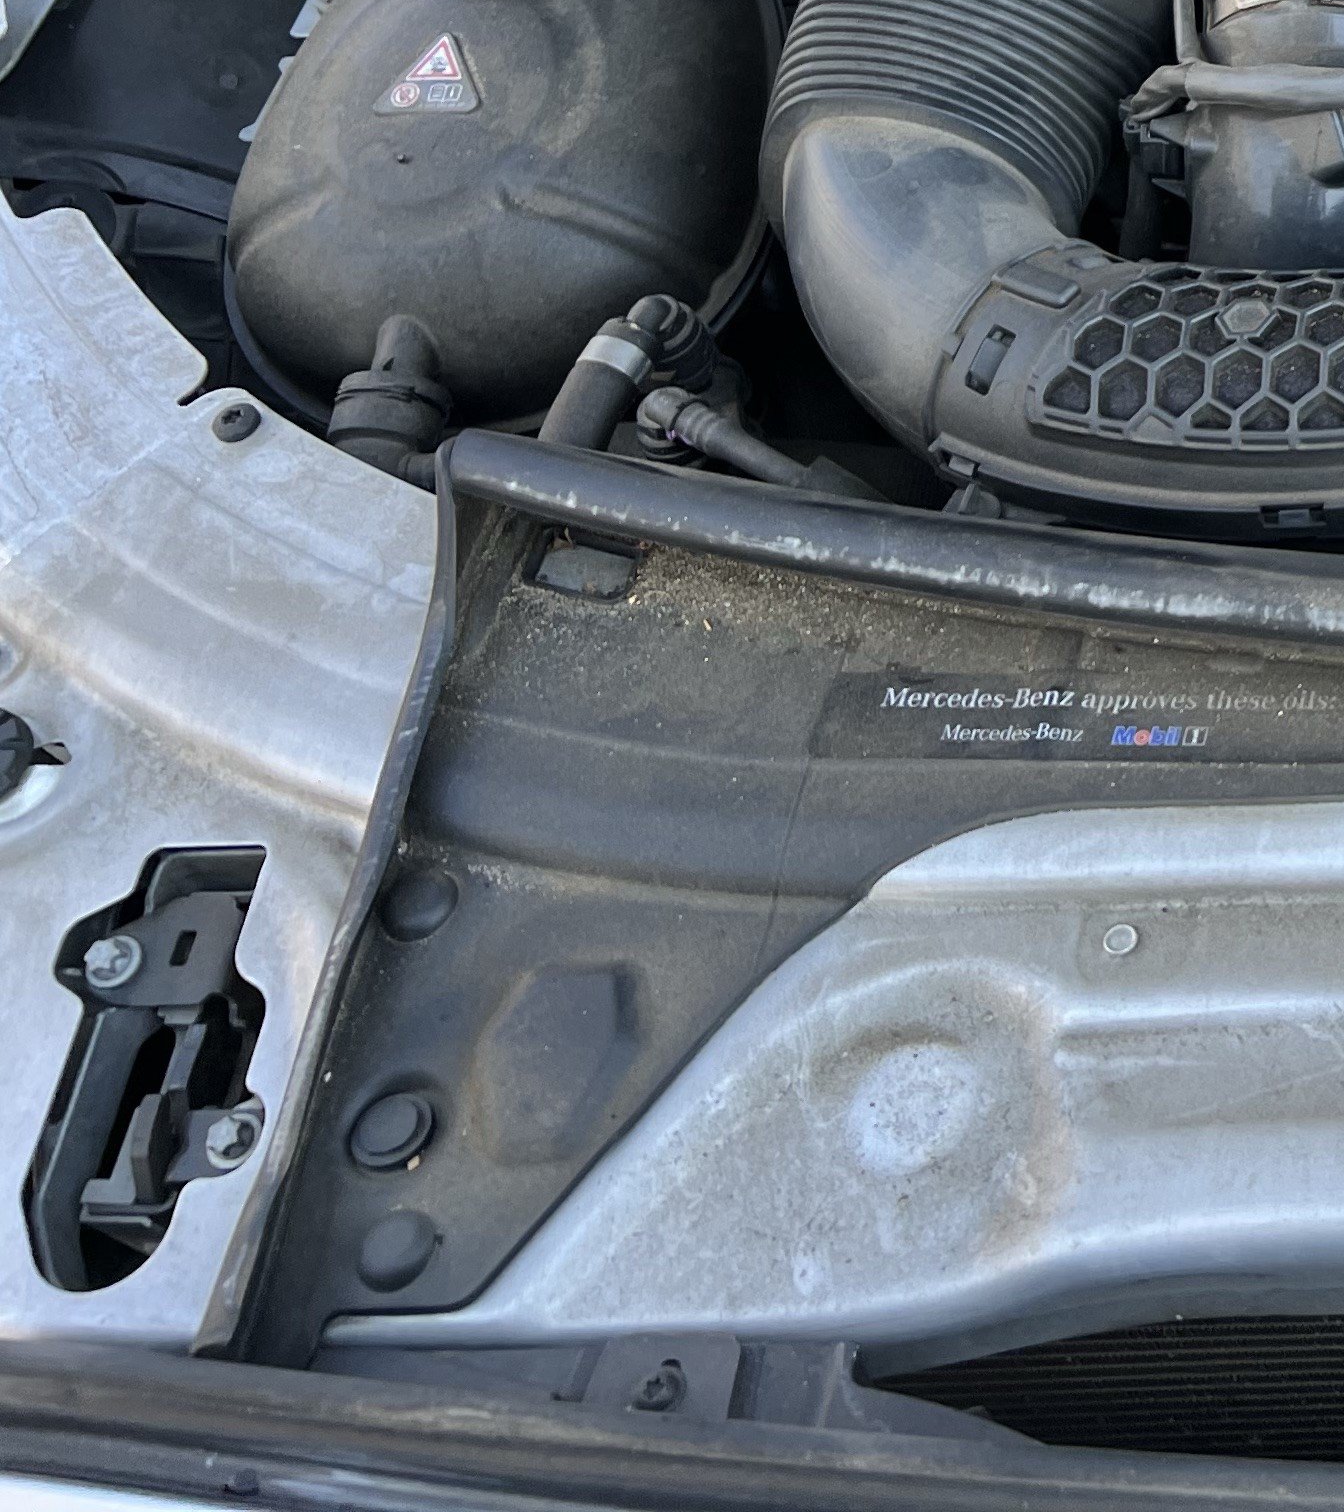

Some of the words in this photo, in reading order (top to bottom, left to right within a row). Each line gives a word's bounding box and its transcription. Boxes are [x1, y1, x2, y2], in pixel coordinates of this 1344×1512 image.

[880, 686, 1076, 710] Mercedes-Benz
[1081, 691, 1198, 714] approves
[1206, 689, 1276, 711] these
[1283, 689, 1336, 711] oils:
[940, 722, 1084, 743] Mercedes-Benz
[1111, 725, 1182, 746] Mobil
